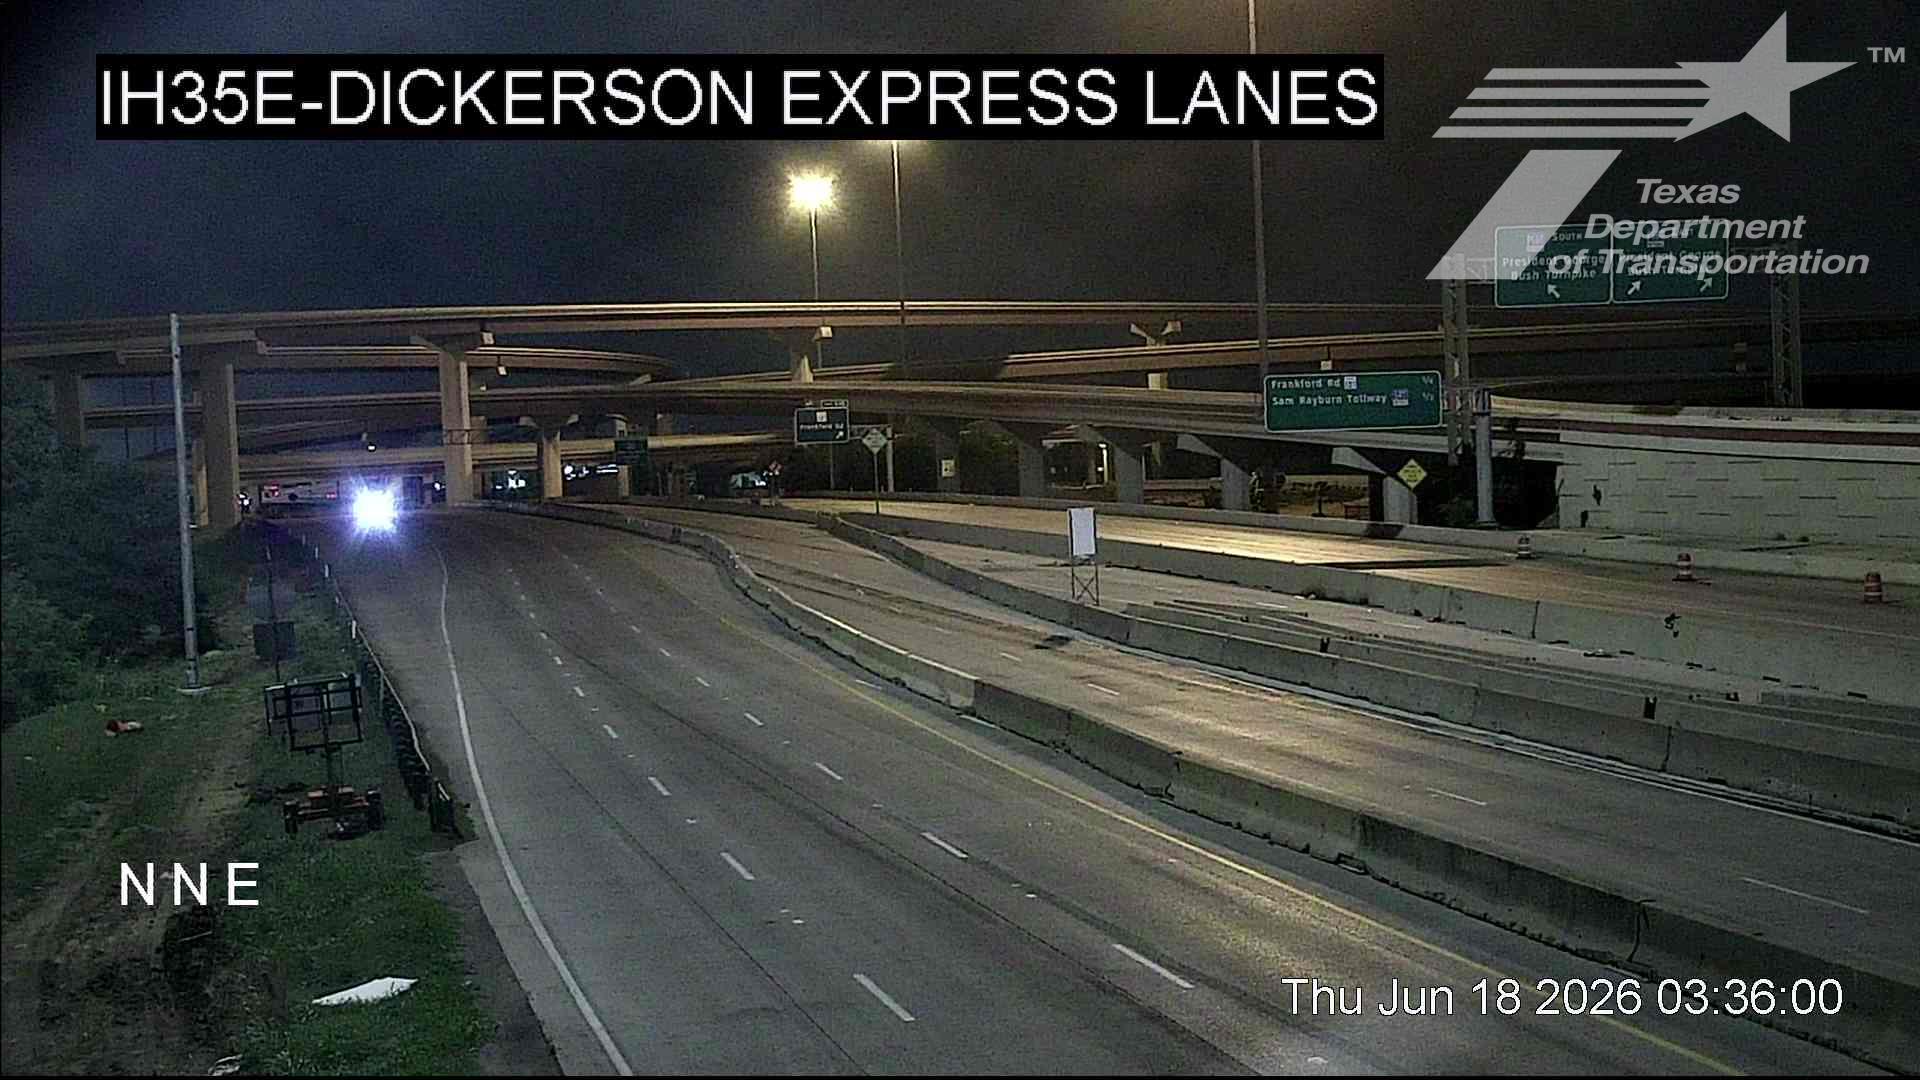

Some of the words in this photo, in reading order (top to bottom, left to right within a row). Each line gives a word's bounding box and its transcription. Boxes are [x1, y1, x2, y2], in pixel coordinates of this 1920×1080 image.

[1502, 255, 1556, 267] Presiden
[1271, 378, 1323, 390] Frankford
[1272, 396, 1295, 406] Sam
[1299, 395, 1343, 407] Rayburn
[1347, 394, 1388, 404] Tollway
